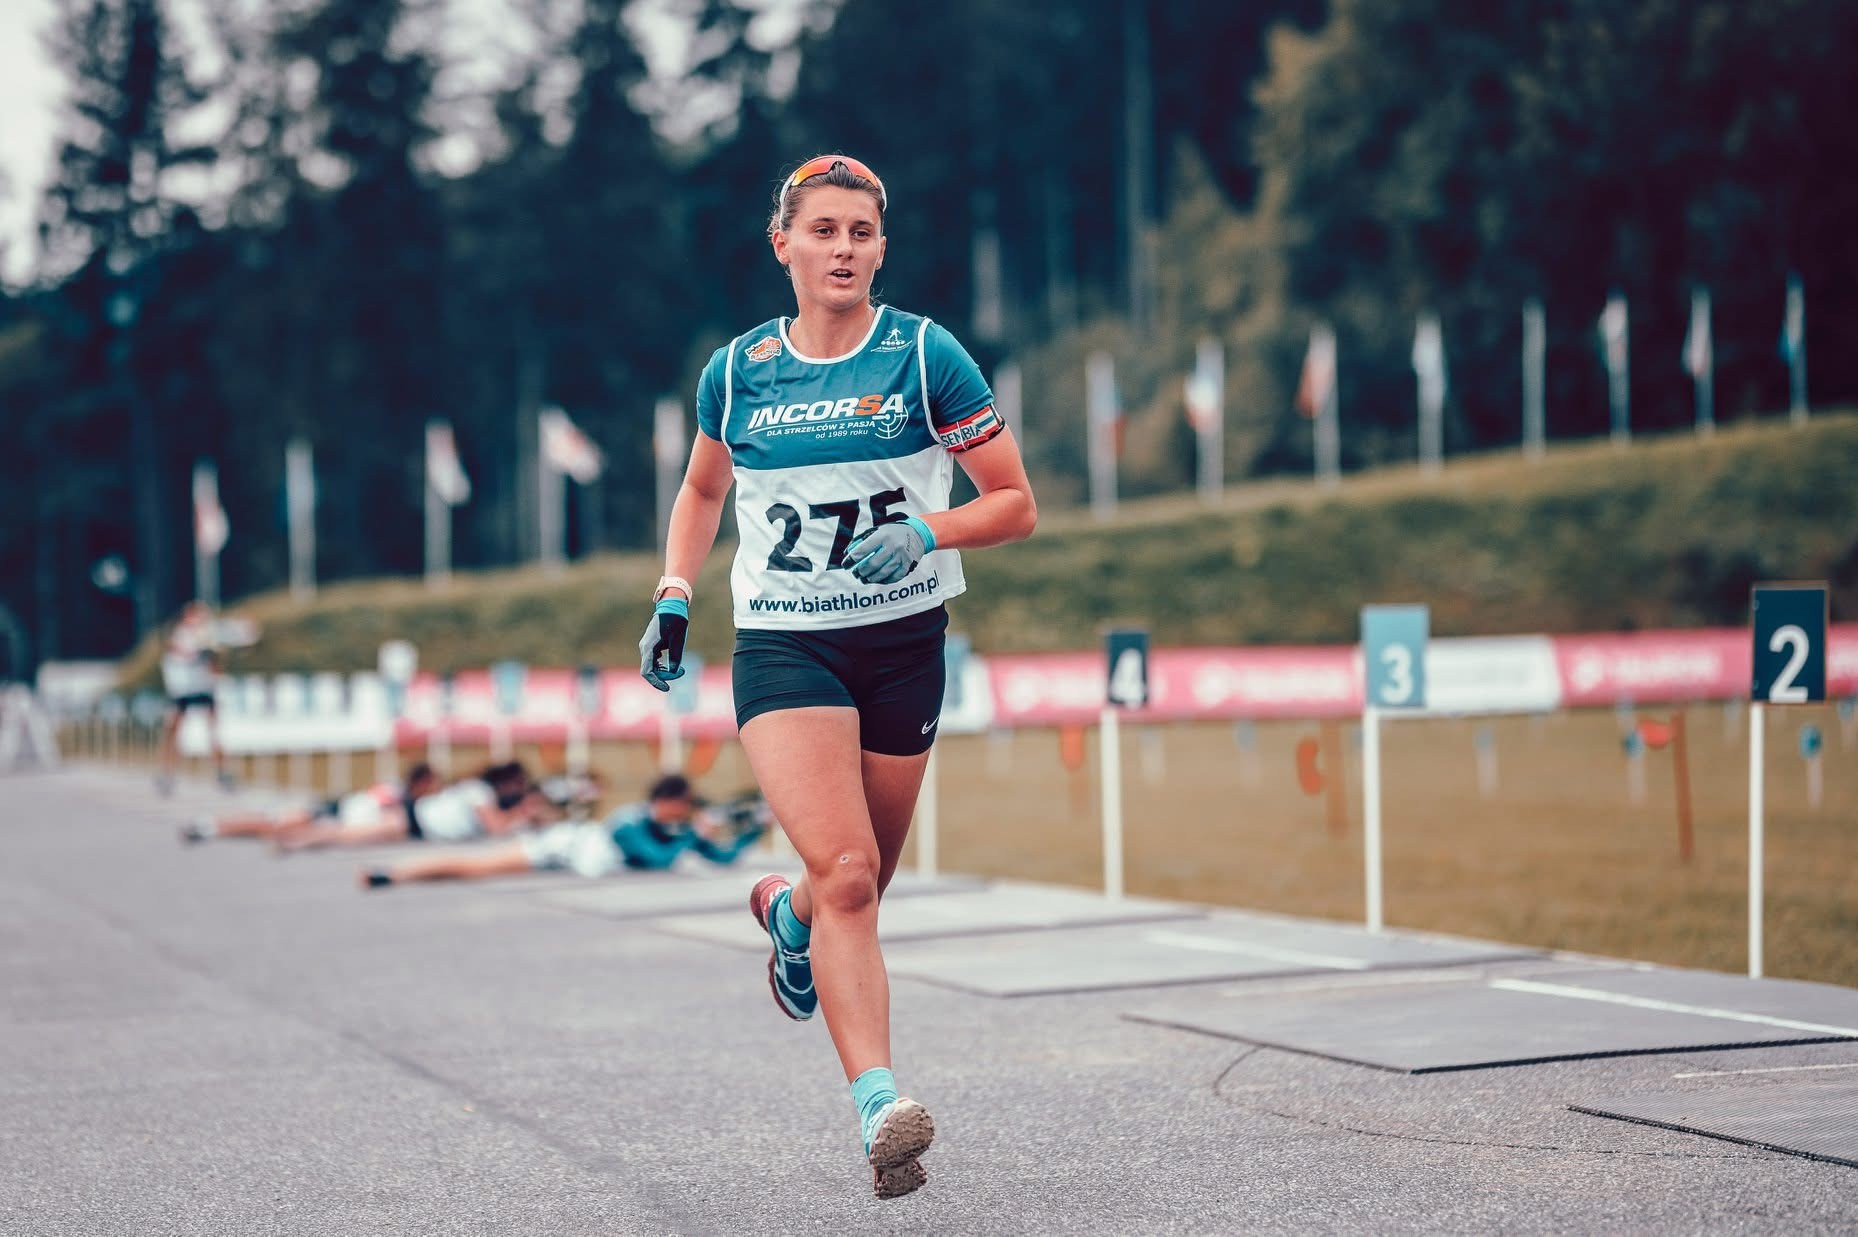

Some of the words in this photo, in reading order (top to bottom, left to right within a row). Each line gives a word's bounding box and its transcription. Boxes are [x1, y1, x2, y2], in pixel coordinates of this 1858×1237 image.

[747, 393, 904, 430] INCORSA
[766, 429, 783, 437] DLA
[784, 422, 838, 435] STRZELCÓW
[839, 421, 846, 430] Z
[847, 420, 876, 429] PASJA
[815, 431, 826, 439] od
[828, 430, 848, 438] 1989
[749, 569, 940, 613] www.biathlon.com.pl
[1110, 647, 1147, 709] 4
[1380, 642, 1415, 705] 3
[1768, 624, 1810, 704] 2
